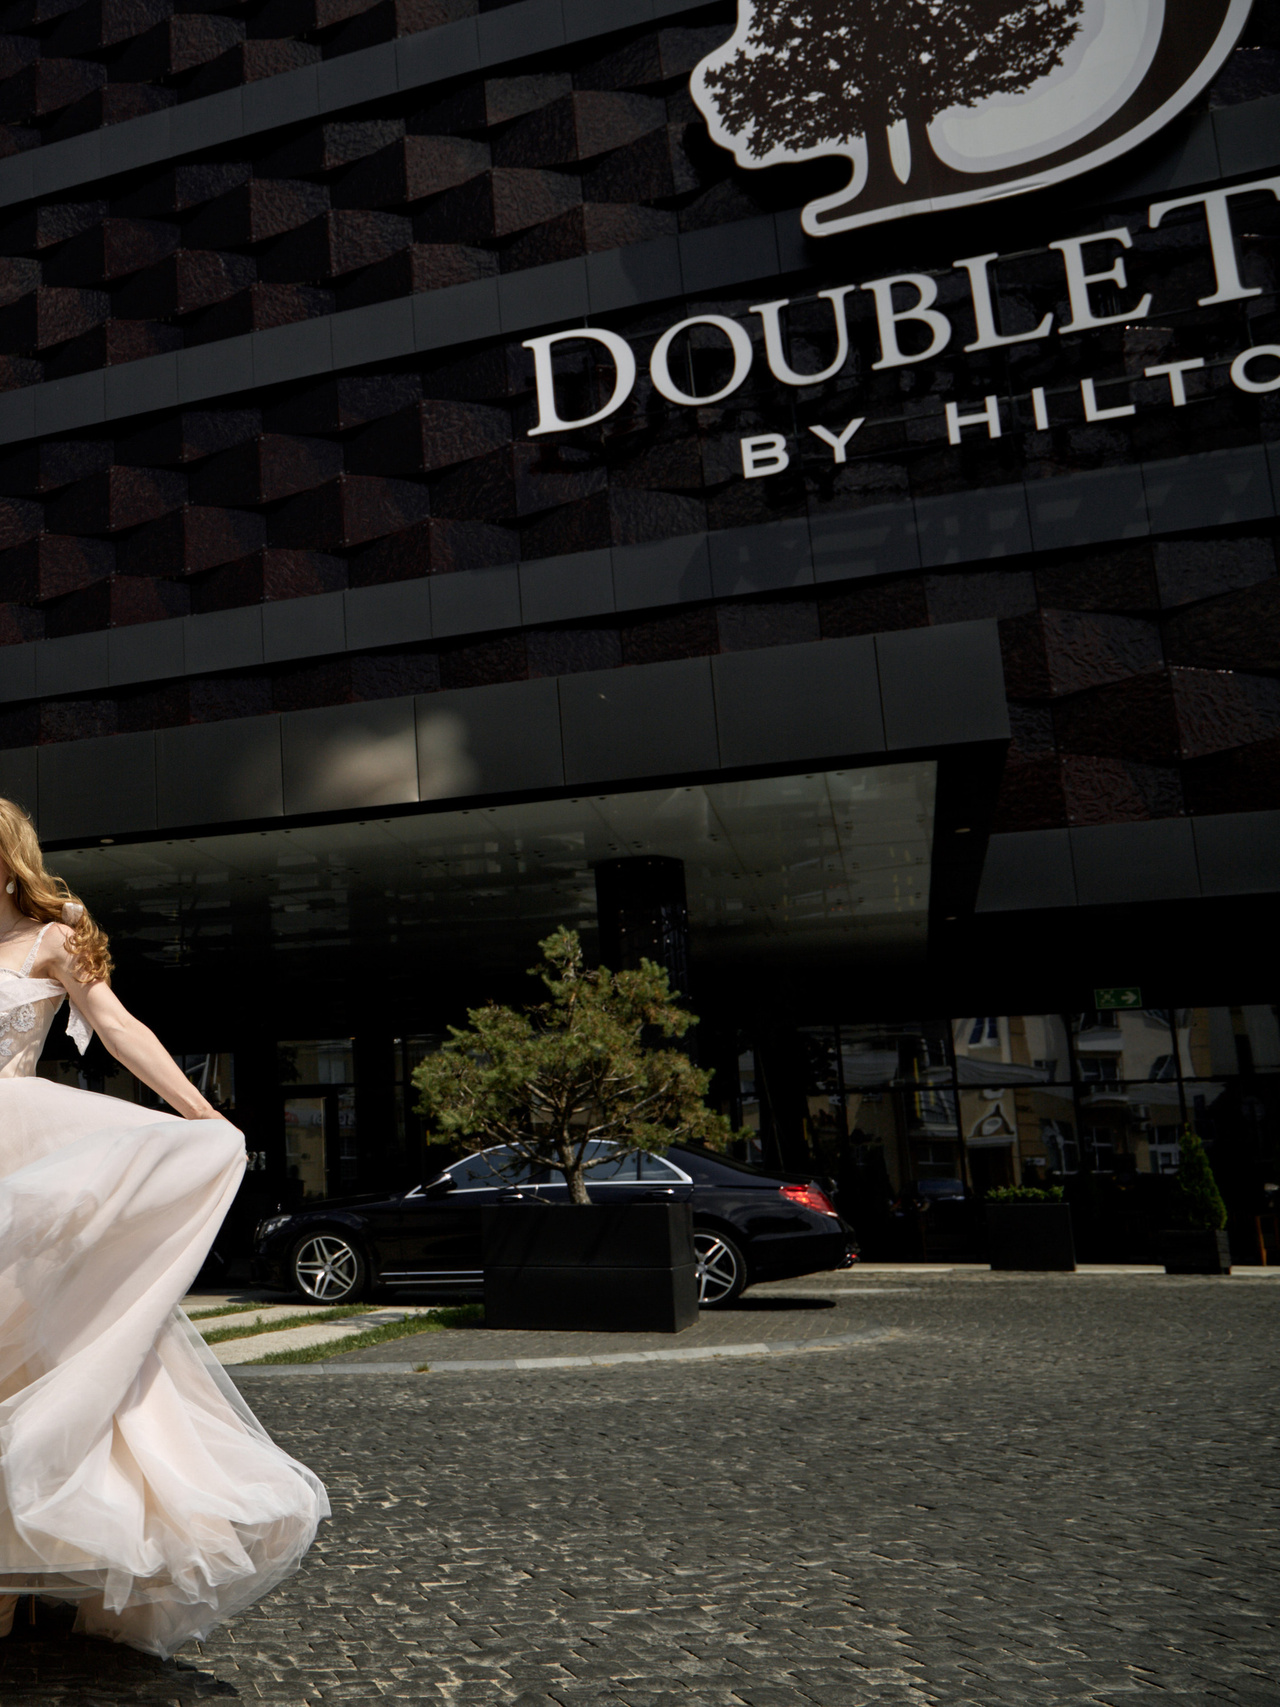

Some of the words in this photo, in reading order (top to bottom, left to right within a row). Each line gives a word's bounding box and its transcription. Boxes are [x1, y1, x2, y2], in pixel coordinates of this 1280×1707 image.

[521, 176, 1280, 437] DOUBLET
[740, 417, 865, 479] BY
[945, 344, 1280, 445] HILTO
